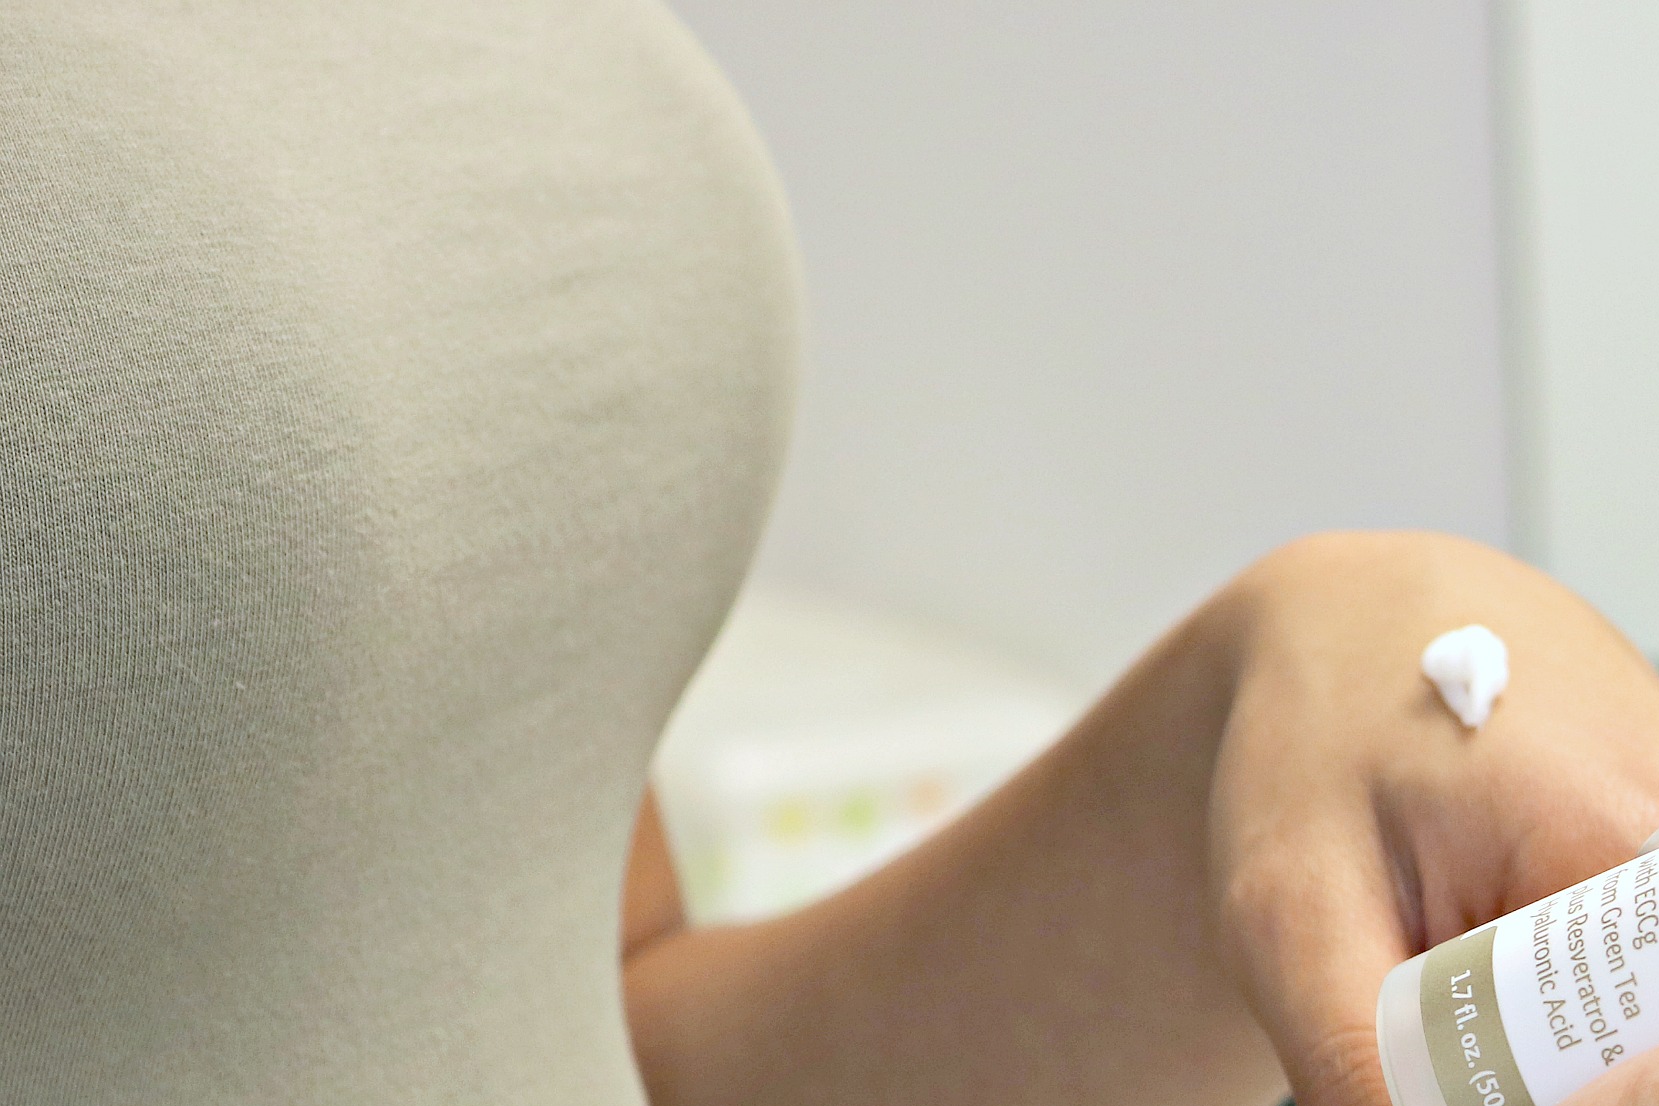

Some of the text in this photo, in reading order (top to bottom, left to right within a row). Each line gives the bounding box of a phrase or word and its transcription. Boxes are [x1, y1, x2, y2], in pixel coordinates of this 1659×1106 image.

[1601, 868, 1641, 1021] from Green Tea
[1632, 855, 1659, 950] with EGCg
[1450, 969, 1473, 1000] 1.7
[1454, 1004, 1478, 1031] fl.
[1530, 897, 1582, 1051] Hyaluronic Acid
[1566, 885, 1624, 1066] plus Resveratrol &
[1461, 1033, 1481, 1068] oz.
